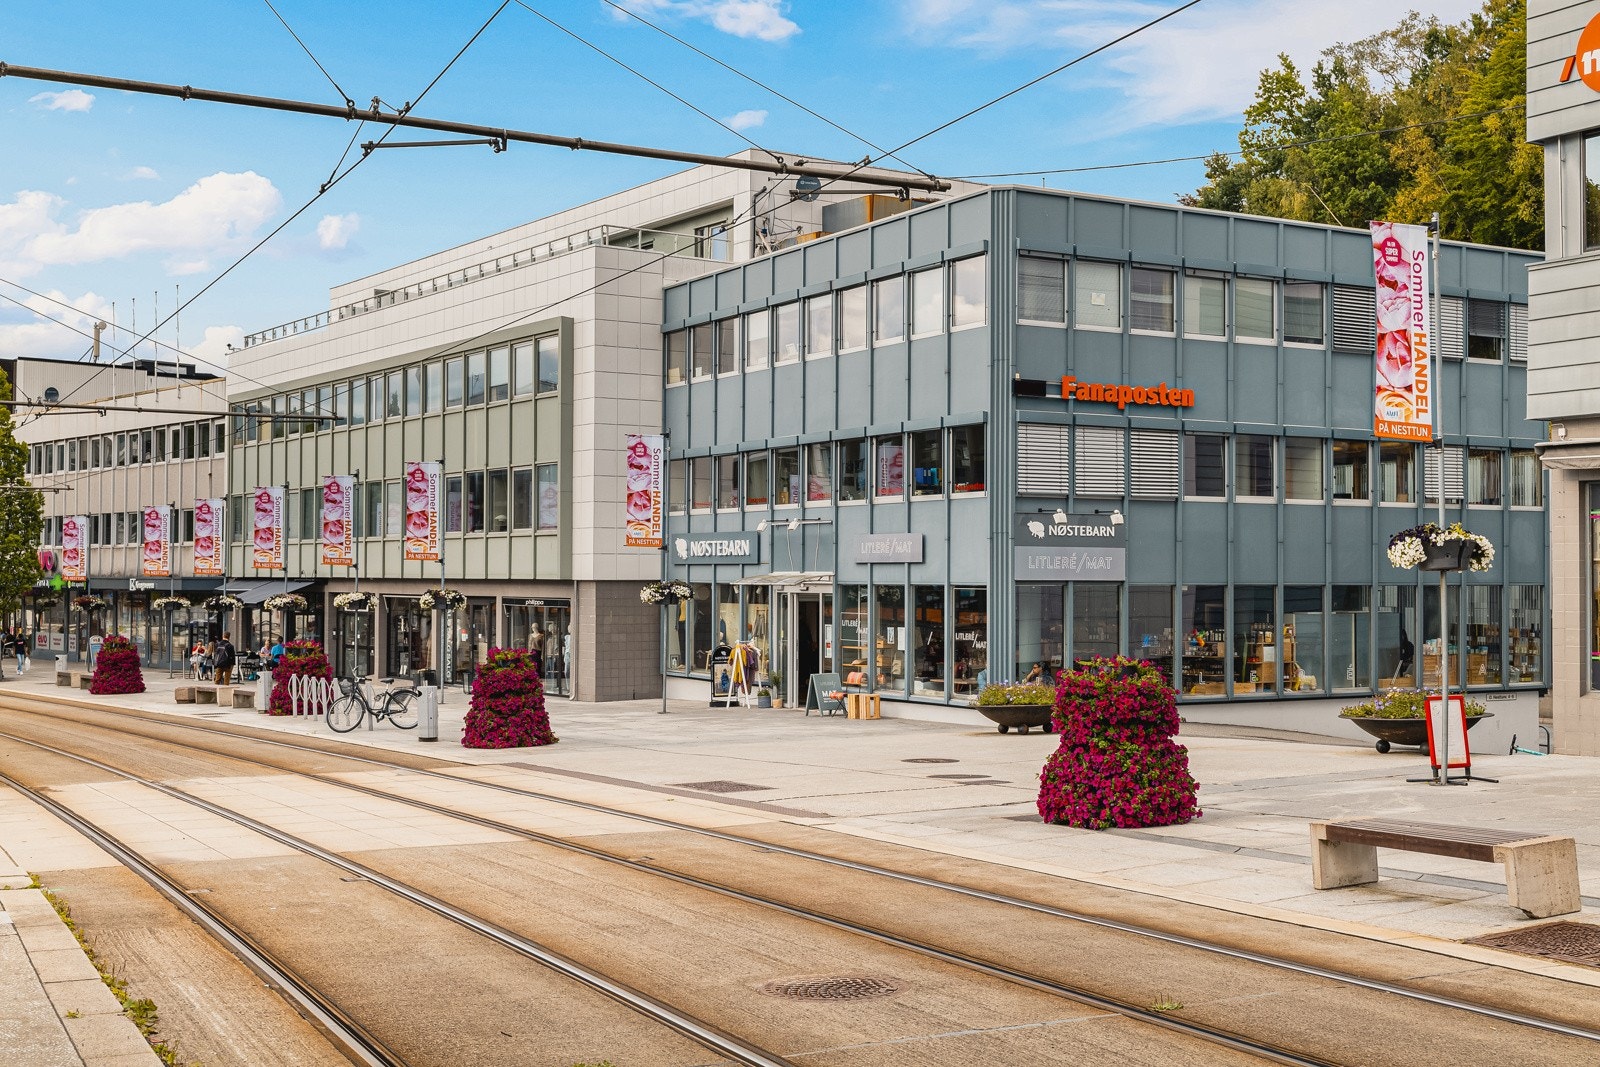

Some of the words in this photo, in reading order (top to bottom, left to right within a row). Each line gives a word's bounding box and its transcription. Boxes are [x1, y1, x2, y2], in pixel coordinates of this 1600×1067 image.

[1061, 375, 1195, 410] Fanaposten
[1379, 422, 1389, 434] PÅ
[1391, 424, 1428, 437] NESTTUN
[1048, 524, 1115, 537] NØSTEBARN
[690, 540, 750, 556] NØSTEBARN
